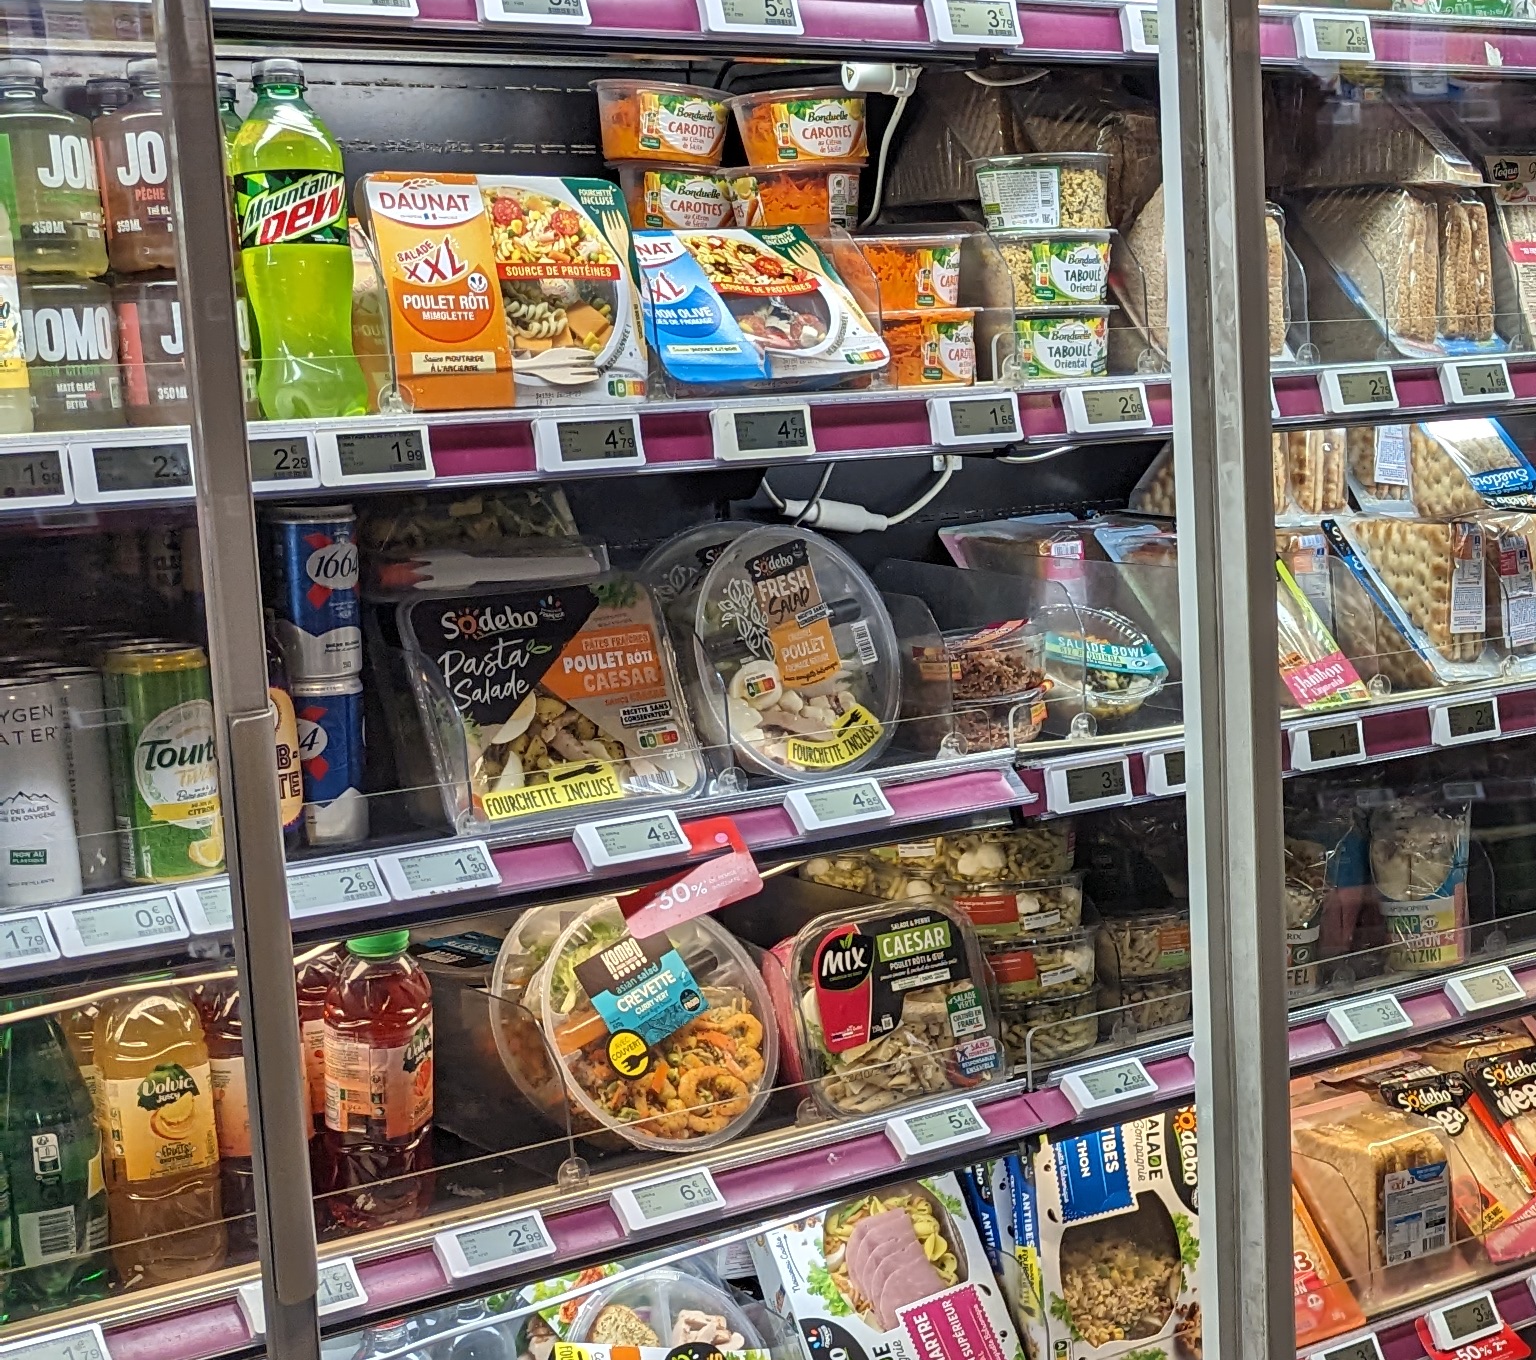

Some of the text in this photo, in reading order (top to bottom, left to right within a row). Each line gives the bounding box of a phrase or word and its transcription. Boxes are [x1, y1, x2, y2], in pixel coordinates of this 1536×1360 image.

[677, 106, 714, 123] Bonduelle
[808, 110, 849, 125] Bonduelle
[668, 122, 716, 139] CAROTTES
[802, 124, 852, 140] CAROTTES
[135, 187, 165, 201] PÊCHE
[246, 172, 335, 230] Mountain
[380, 191, 470, 214] DAUNAT
[581, 194, 615, 207] INCLUSE
[678, 184, 721, 200] Bonduelle
[670, 200, 723, 217] CAROTTES
[397, 239, 435, 263] SALADE
[404, 235, 467, 284] XXL
[506, 262, 612, 277] SOURCE DE PROTÉINES
[1064, 267, 1101, 283] TABOULÉ
[403, 292, 490, 311] POULET RÔTI
[678, 306, 714, 319] OLIVE
[1047, 342, 1092, 360] TABOULÉ
[1054, 358, 1087, 369] Oriental
[314, 552, 358, 579] 1664
[753, 554, 794, 577] Sodebo
[757, 569, 808, 601] FRESH
[769, 587, 811, 624] SALAD
[440, 606, 538, 639] Sodebo
[563, 650, 654, 674] POULET RÔTI
[781, 637, 826, 663] POULET
[1111, 643, 1146, 658] BOWL
[438, 638, 531, 687] Pasta
[583, 668, 659, 692] CAESAR
[454, 679, 529, 710] Salade
[0, 703, 53, 724] YGEN
[792, 722, 879, 764] FOURCHETTE INCLUSE
[485, 776, 619, 818] FOURCHETTE INCLUSE
[882, 927, 946, 958] CAESAR
[600, 937, 645, 974] KOMBO
[616, 970, 677, 1013] CREVETTE
[611, 1040, 643, 1064] COUVERT
[142, 1074, 195, 1097] Volvic
[1398, 1087, 1452, 1112] Sodebo
[1075, 1136, 1091, 1179] THON
[941, 1300, 972, 1359] SUPÉRIEUR
